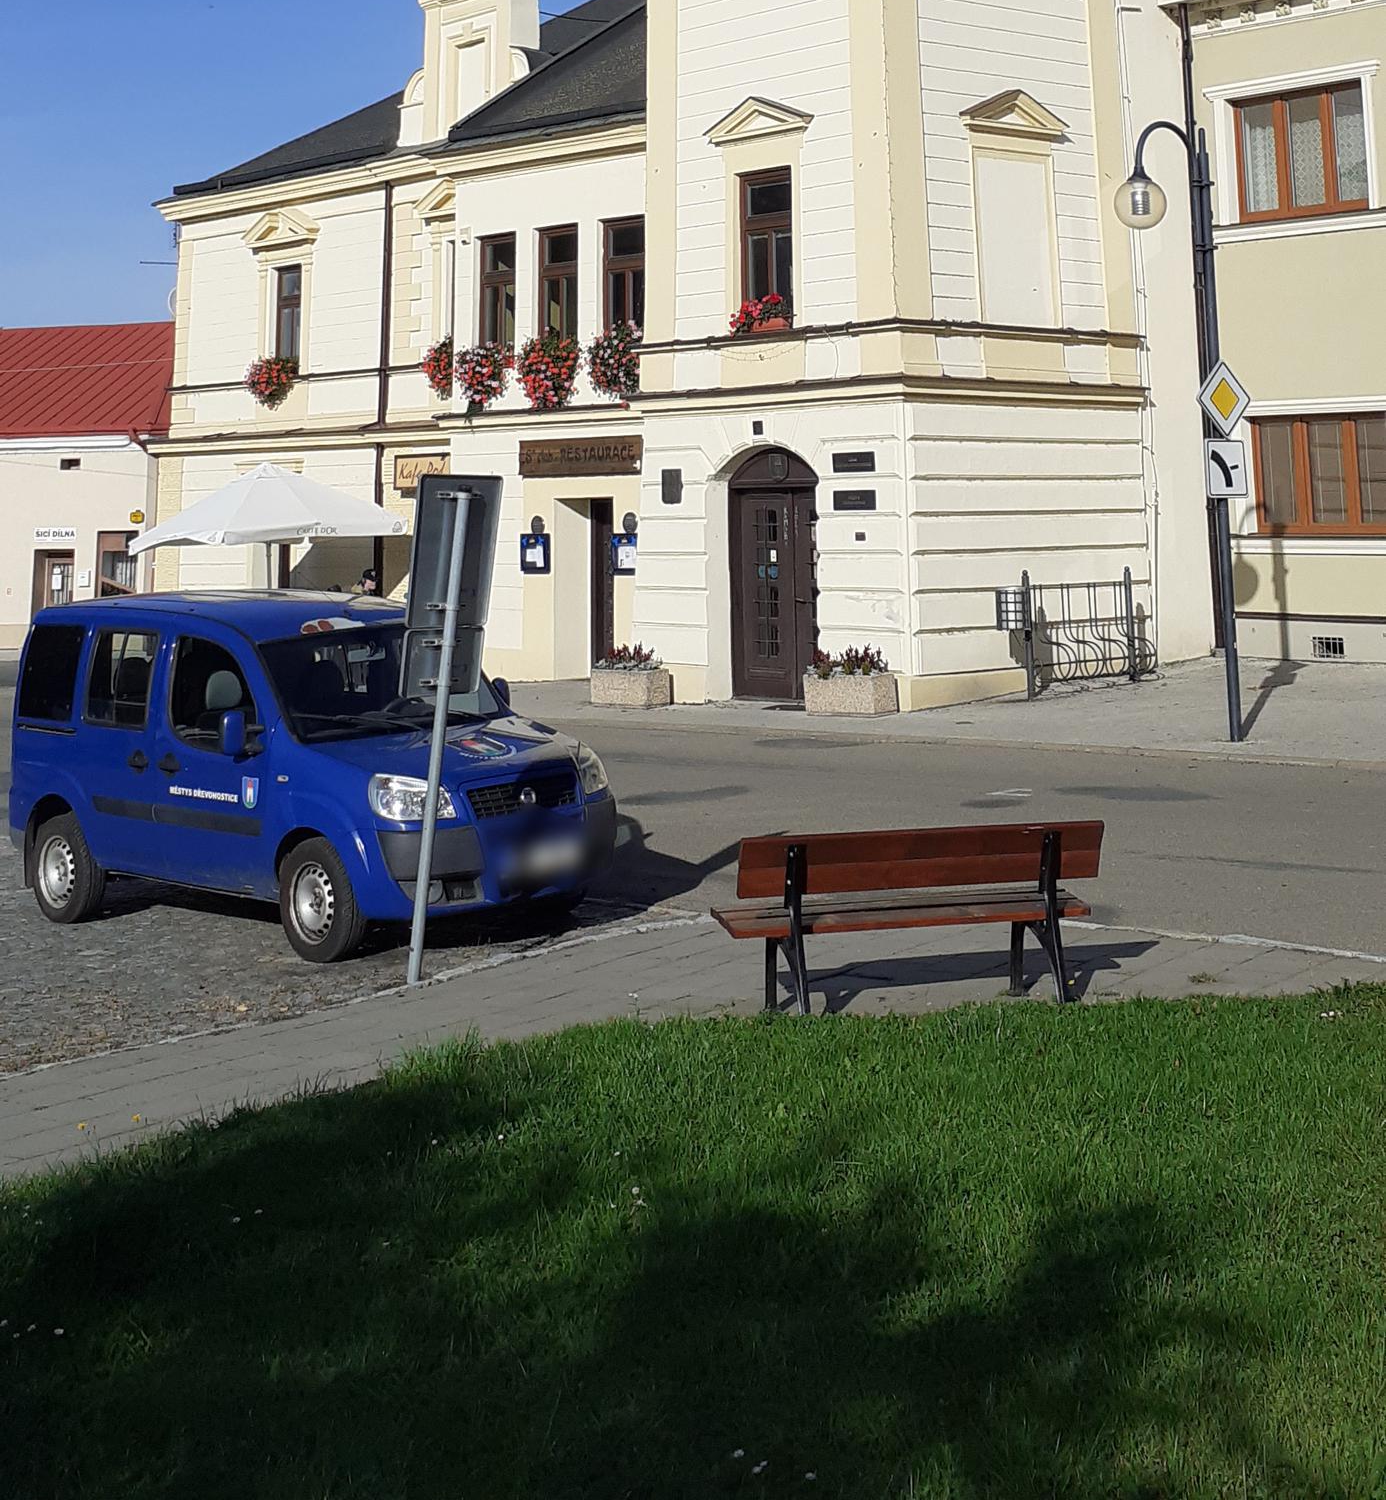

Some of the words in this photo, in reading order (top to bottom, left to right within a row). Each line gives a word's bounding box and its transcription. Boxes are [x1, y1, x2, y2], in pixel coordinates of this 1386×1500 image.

[560, 444, 636, 463] RESTAURACE
[35, 528, 51, 538] ŠICÍ
[52, 529, 75, 538] DÍLNA
